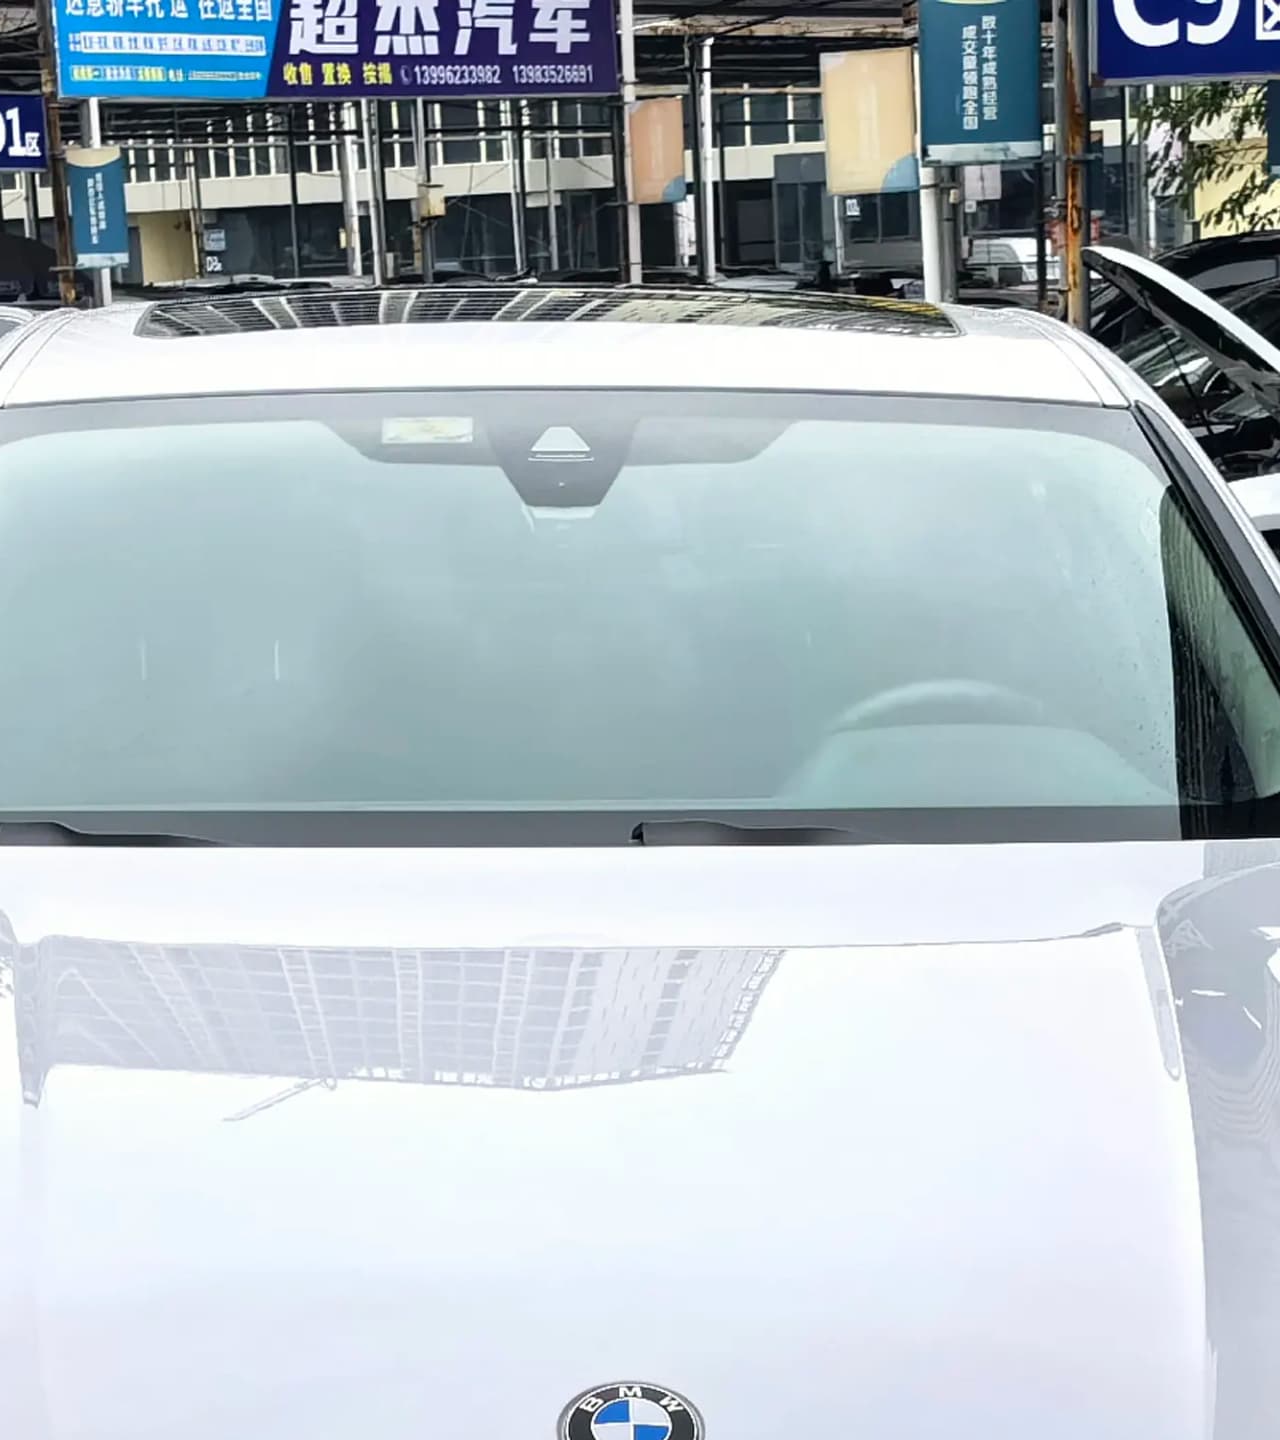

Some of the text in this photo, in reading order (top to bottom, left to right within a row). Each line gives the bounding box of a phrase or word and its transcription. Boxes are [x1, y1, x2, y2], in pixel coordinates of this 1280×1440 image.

[289, 0, 591, 56] 超杰汽车
[579, 1386, 684, 1413] BMW
